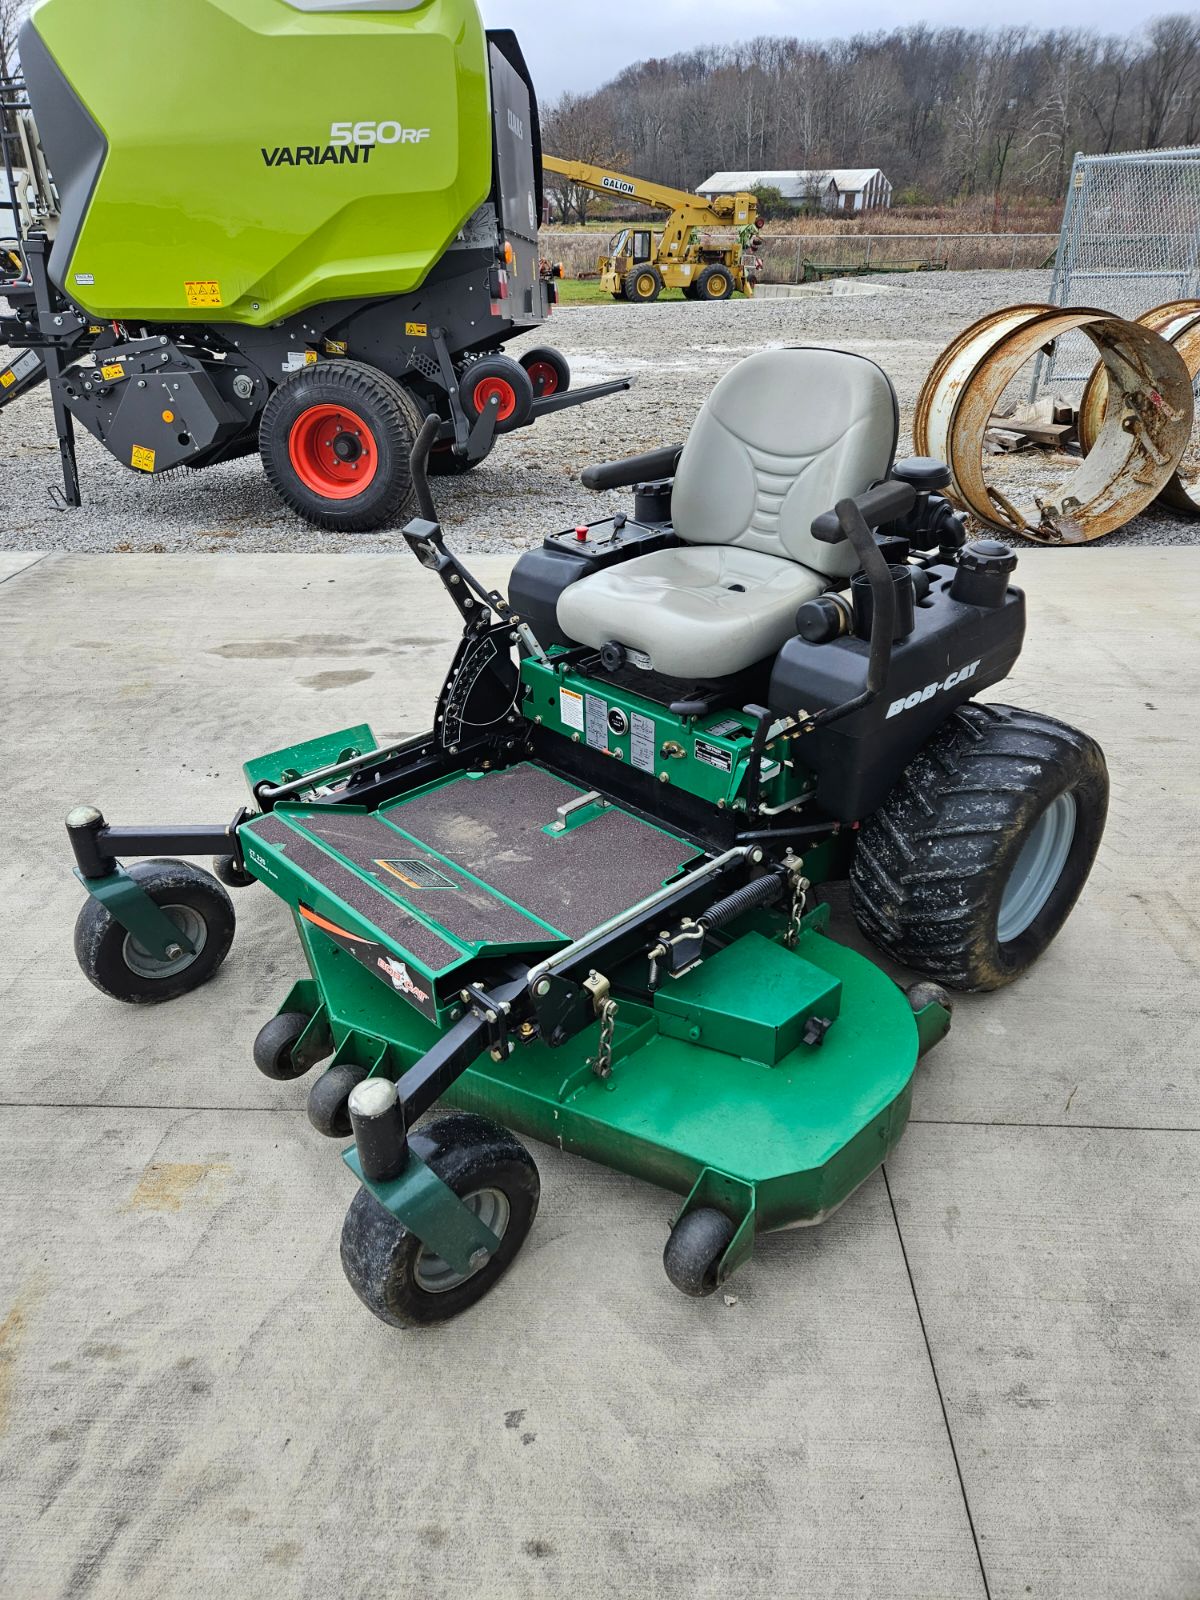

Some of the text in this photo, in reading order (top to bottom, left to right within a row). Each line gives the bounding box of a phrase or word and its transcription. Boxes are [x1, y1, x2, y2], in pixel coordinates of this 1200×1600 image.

[260, 144, 376, 167] VARIANT
[603, 178, 634, 193] GALION
[885, 659, 982, 720] BOB-CAT
[377, 957, 429, 1003] BOB-CAT
